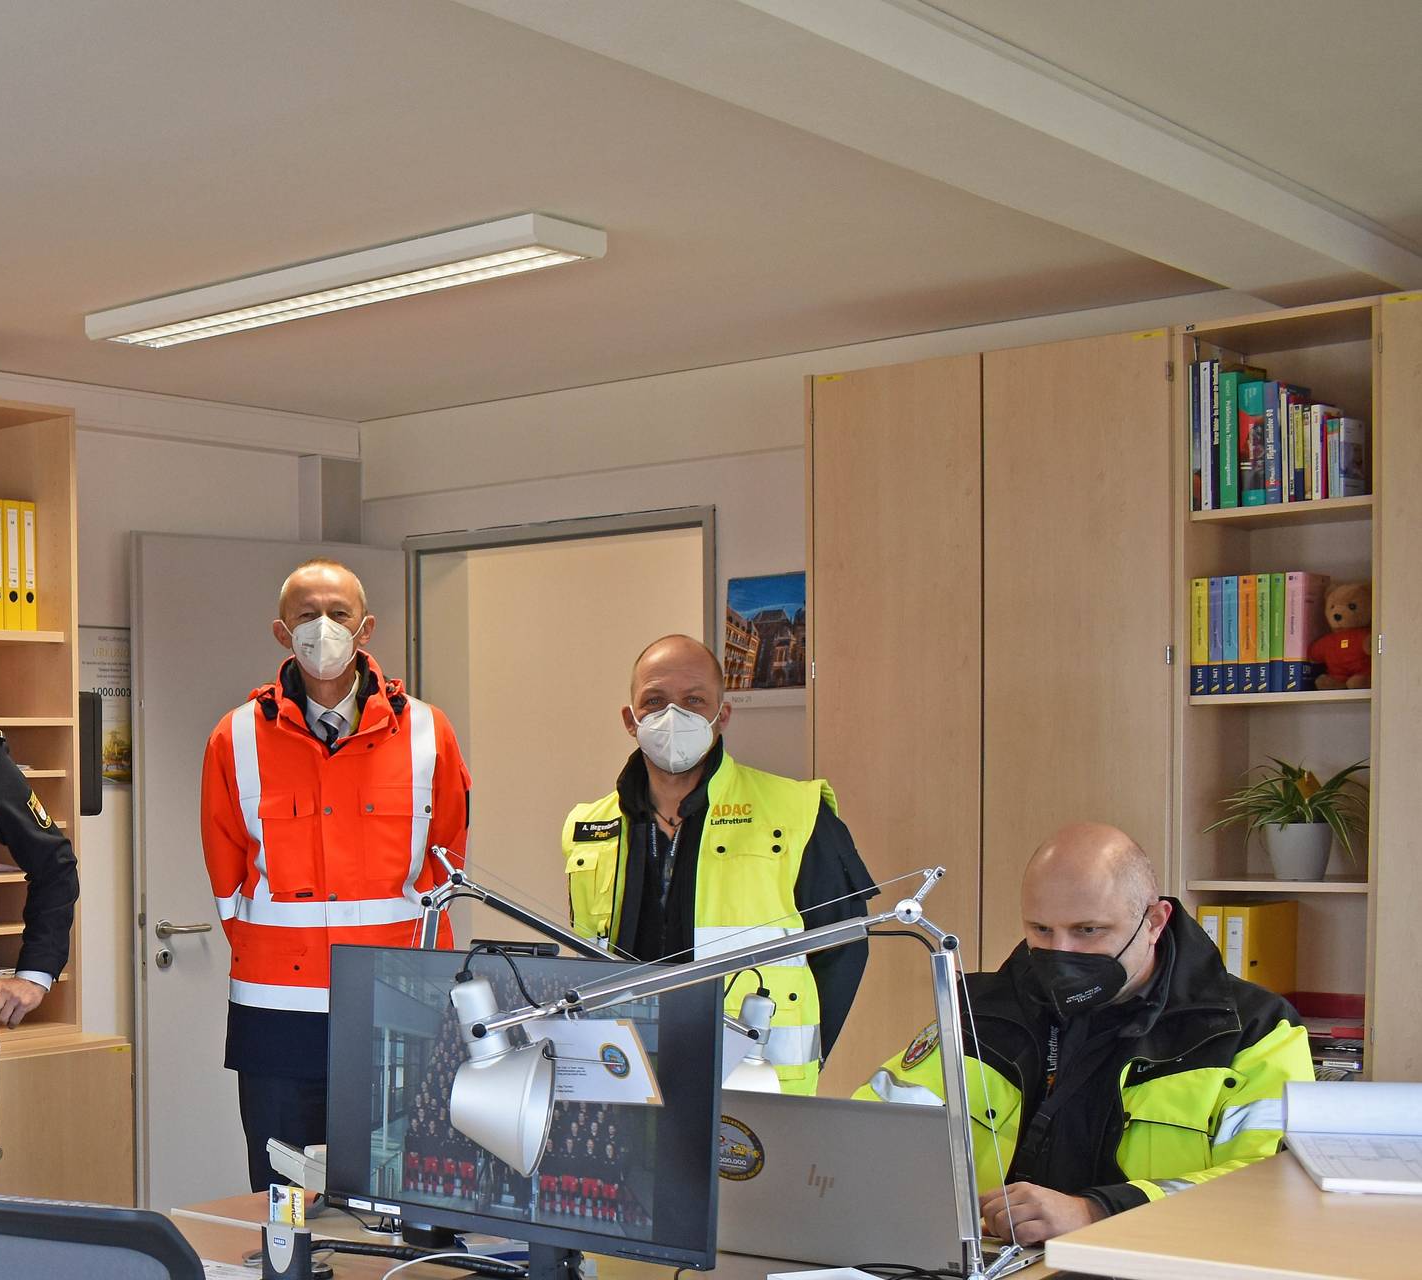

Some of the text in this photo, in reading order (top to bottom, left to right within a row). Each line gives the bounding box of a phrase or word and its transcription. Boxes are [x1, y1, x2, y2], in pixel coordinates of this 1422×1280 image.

[1267, 445, 1276, 460] Flight
[711, 804, 752, 817] ADAC
[710, 817, 753, 826] Luftrettung
[1046, 1025, 1059, 1072] Luftrettung
